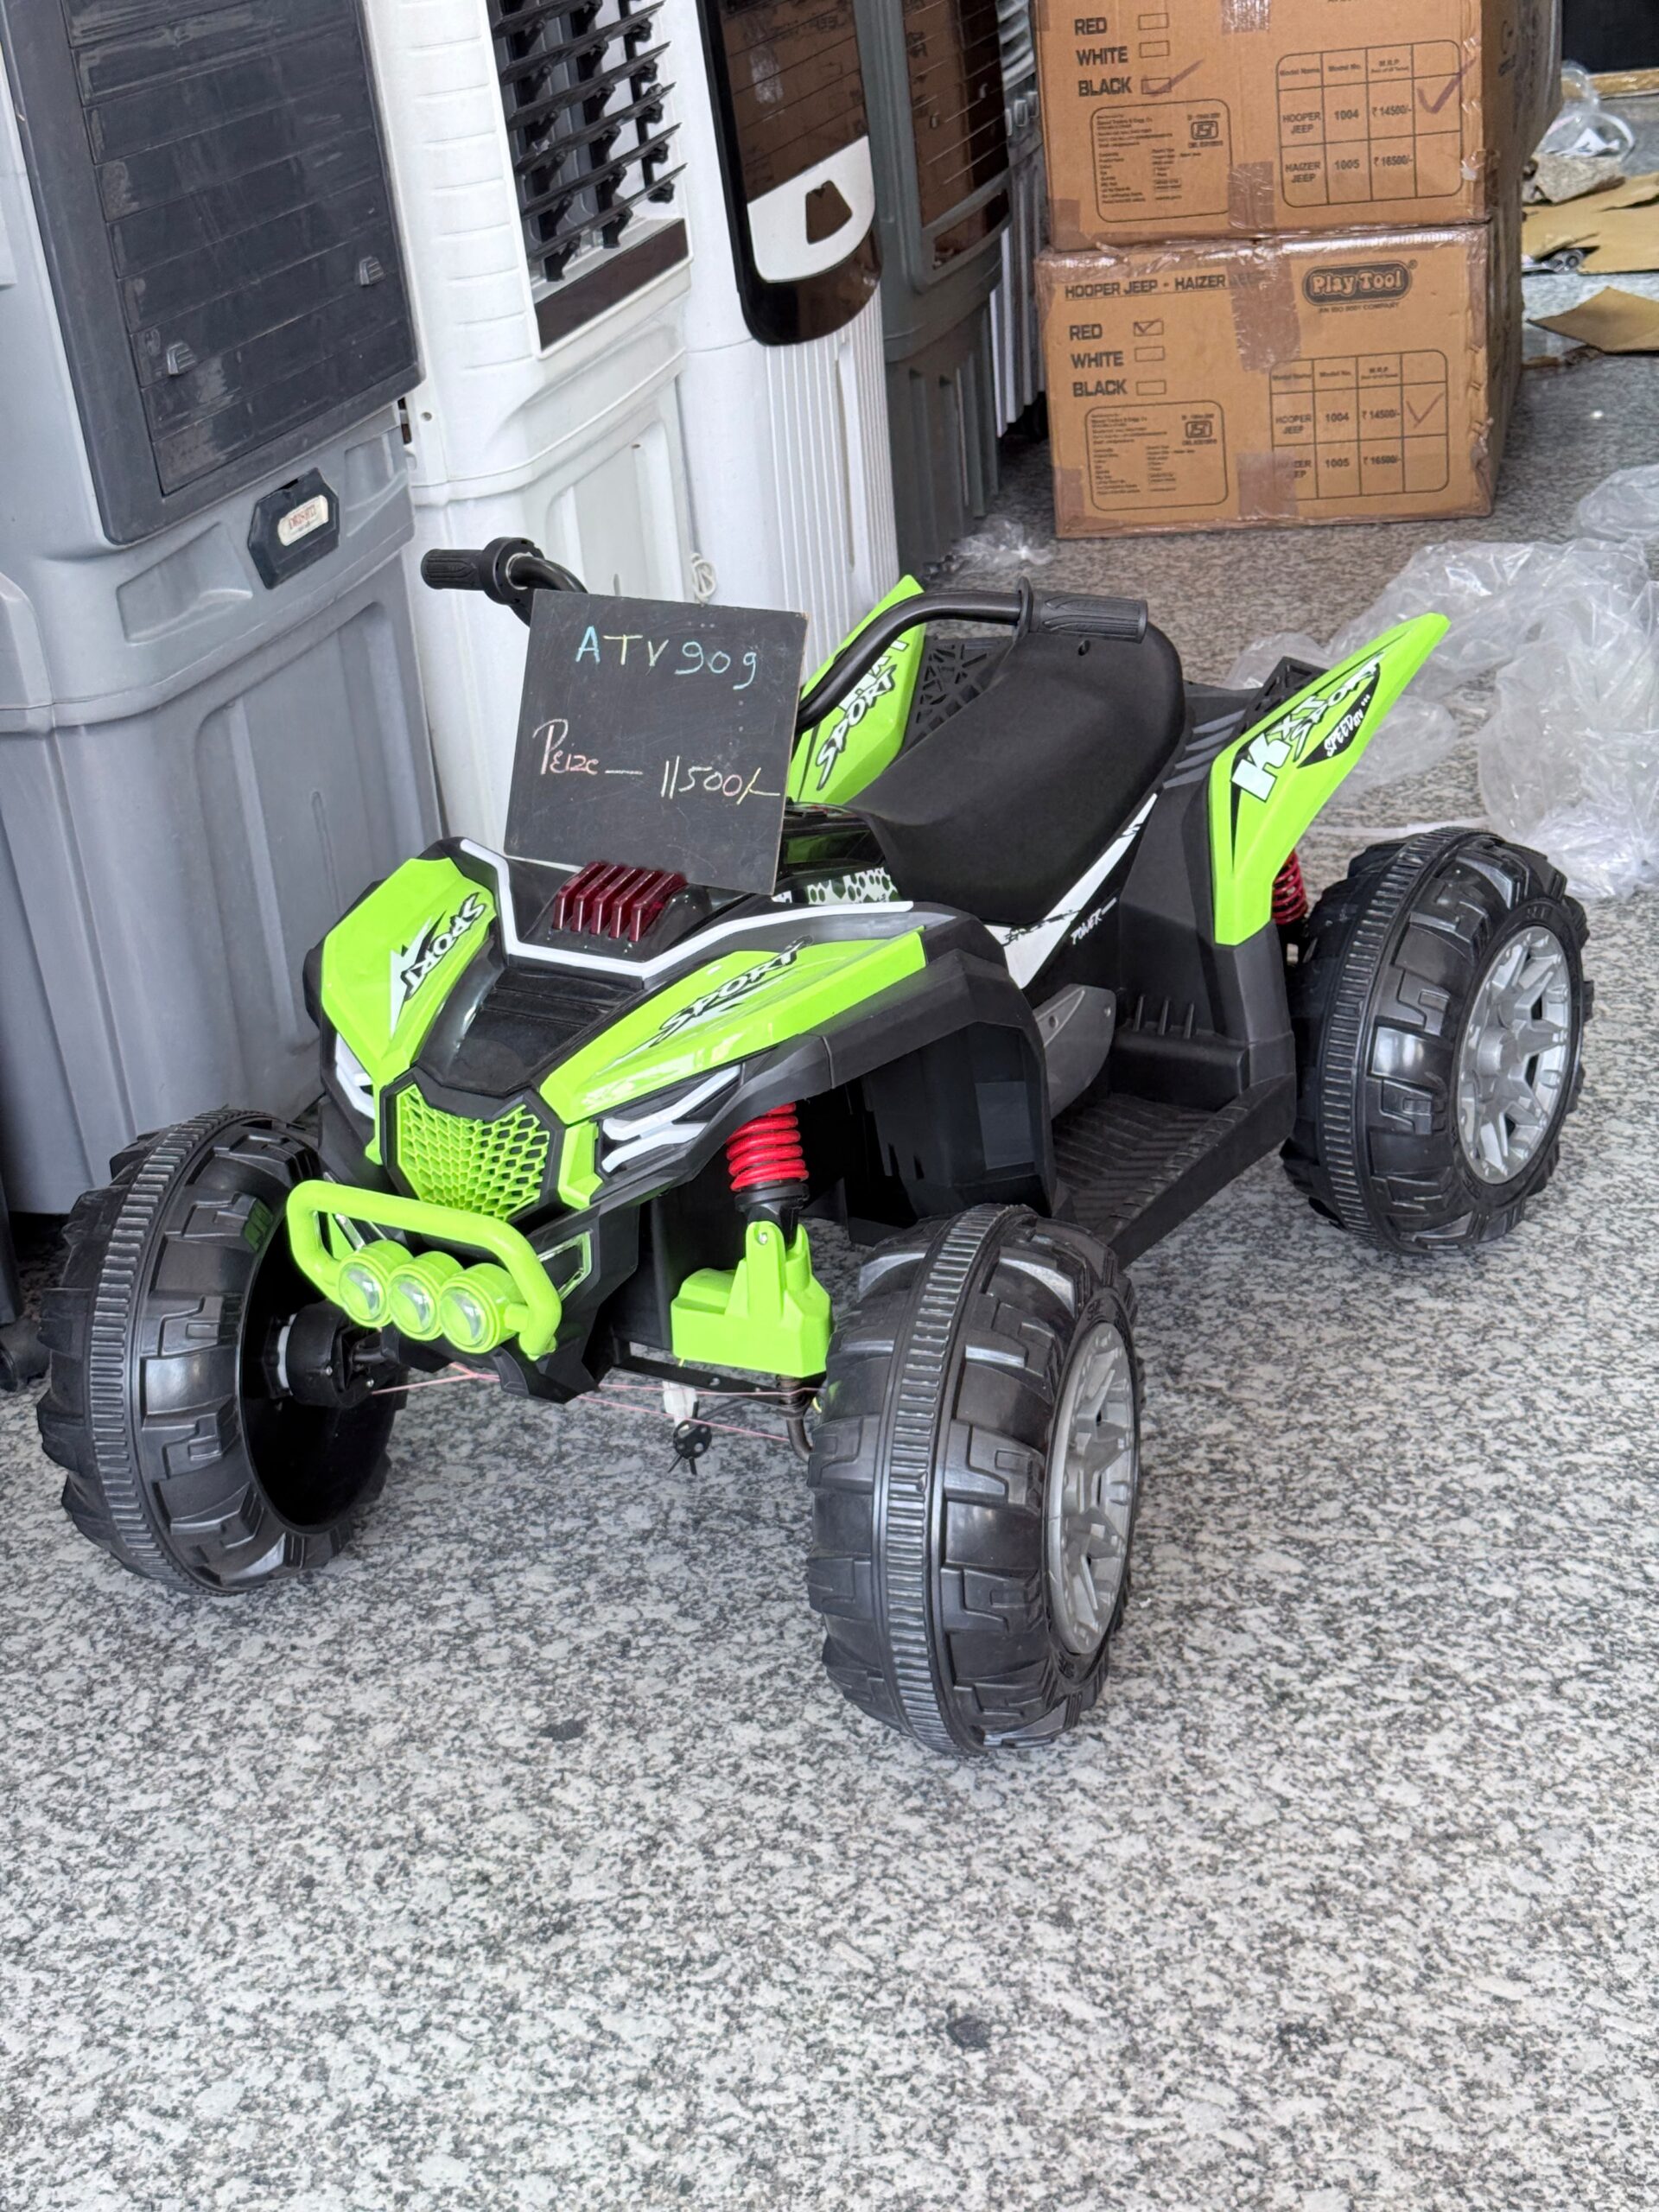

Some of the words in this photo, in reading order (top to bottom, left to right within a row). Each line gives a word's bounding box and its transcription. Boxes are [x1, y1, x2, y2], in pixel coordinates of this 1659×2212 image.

[1074, 16, 1108, 35] RED
[1076, 45, 1128, 67] WHITE
[1078, 76, 1133, 97] BLACK
[1282, 111, 1322, 124] HOOPER
[1334, 109, 1360, 121] 1004
[1380, 105, 1412, 116] 14500/-
[1291, 124, 1313, 135] JEEP
[1285, 162, 1321, 174] HAIZER
[1334, 159, 1361, 171] 1005
[1292, 174, 1316, 184] JEEP
[1065, 282, 1121, 299] HOOPER
[1123, 279, 1158, 295] JEEP
[1174, 274, 1226, 290] HAIZER
[1312, 273, 1355, 296] Play
[1359, 268, 1403, 290] Tool
[1069, 323, 1103, 340] RED
[1071, 351, 1124, 369] WHITE
[1072, 379, 1128, 397] BLACK
[1325, 411, 1350, 422] 1004
[1325, 457, 1350, 467] 1005
[815, 664, 899, 791] SPORT
[1324, 715, 1355, 758] SPEED
[400, 892, 488, 1002] SPORT
[647, 935, 814, 1048] SPORT
